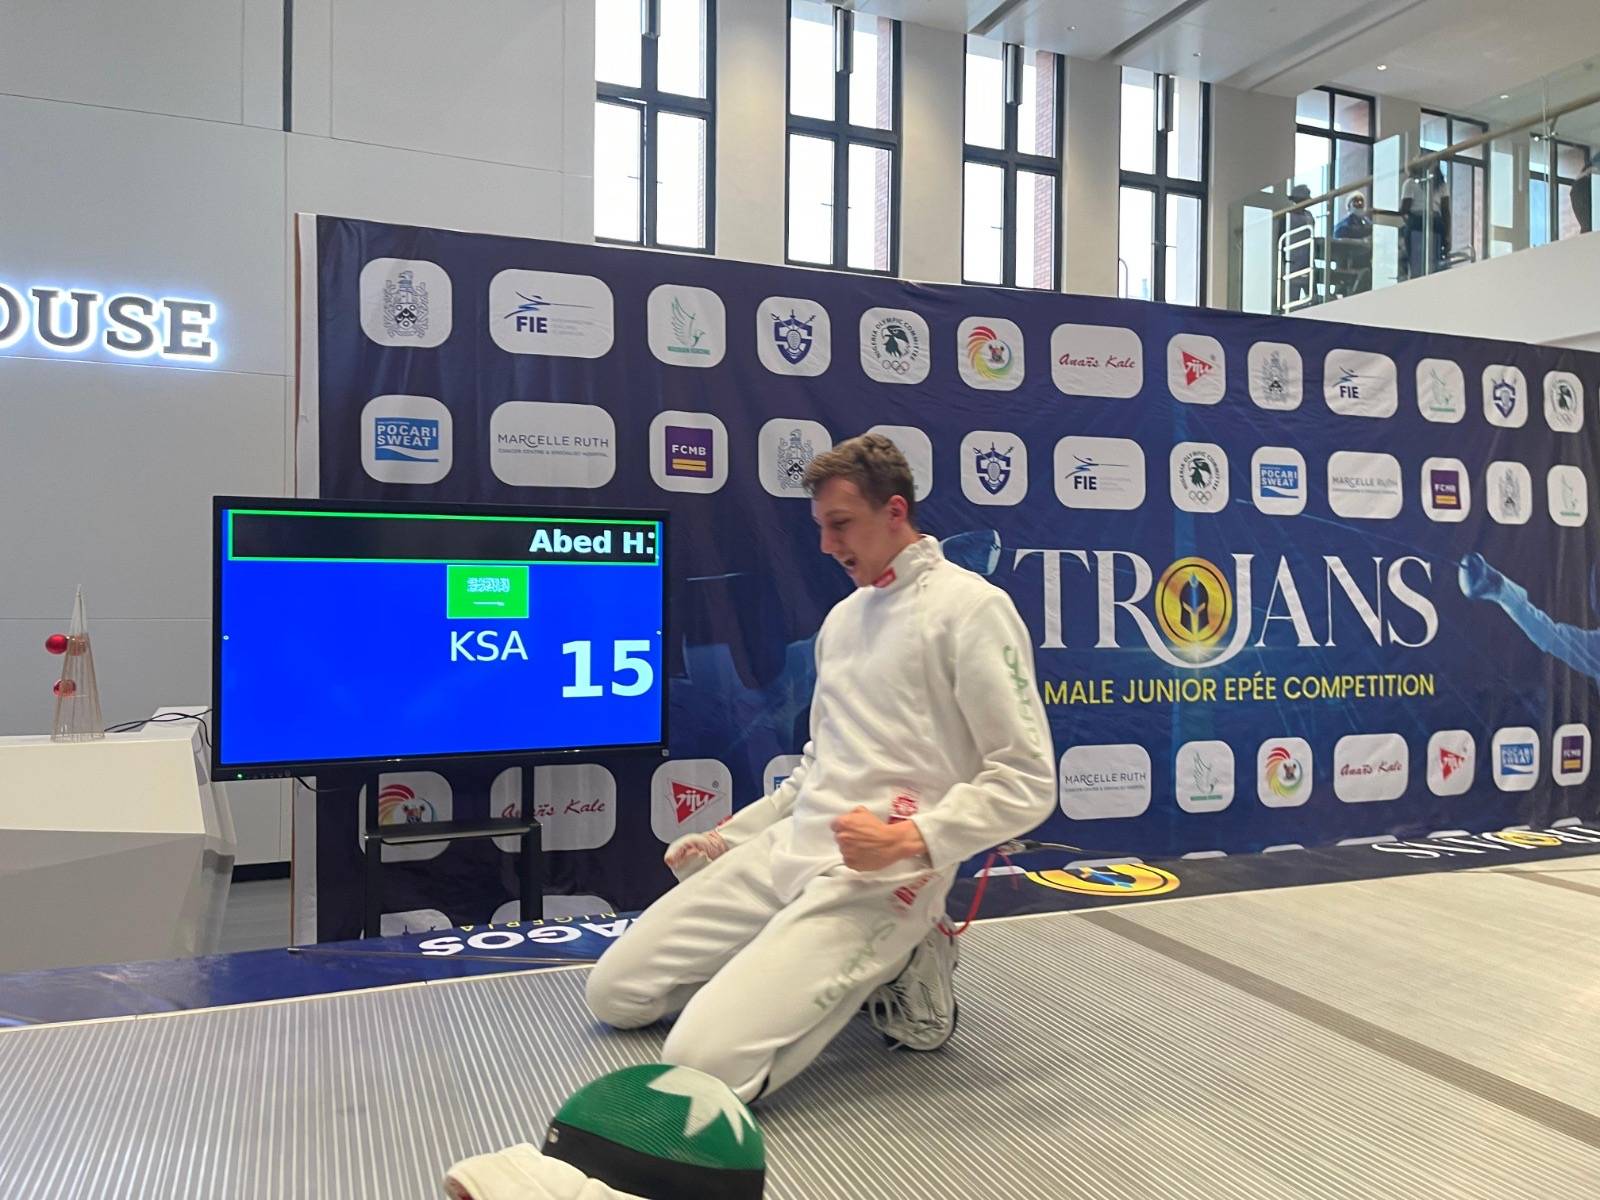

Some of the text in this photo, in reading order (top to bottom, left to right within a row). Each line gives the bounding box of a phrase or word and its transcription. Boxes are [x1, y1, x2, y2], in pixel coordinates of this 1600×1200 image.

[515, 315, 548, 334] FIE
[1339, 385, 1359, 399] FIE
[377, 424, 437, 438] POCARI
[377, 435, 432, 448] SWEAT
[497, 433, 609, 448] MARCELLE RUTH
[671, 444, 707, 456] FCMB
[1073, 475, 1097, 490] FIE
[1260, 470, 1298, 480] POCARI
[1261, 478, 1294, 487] SWEAT
[528, 528, 612, 553] Abed
[1011, 548, 1440, 669] TROJANS
[450, 630, 529, 662] KSA
[561, 638, 655, 698] 15
[1043, 671, 1435, 705] MALE JUNIOR EPÉE COMPETITION
[1064, 772, 1146, 786] MARCELLE RUTH
[418, 919, 638, 956] AGOS
